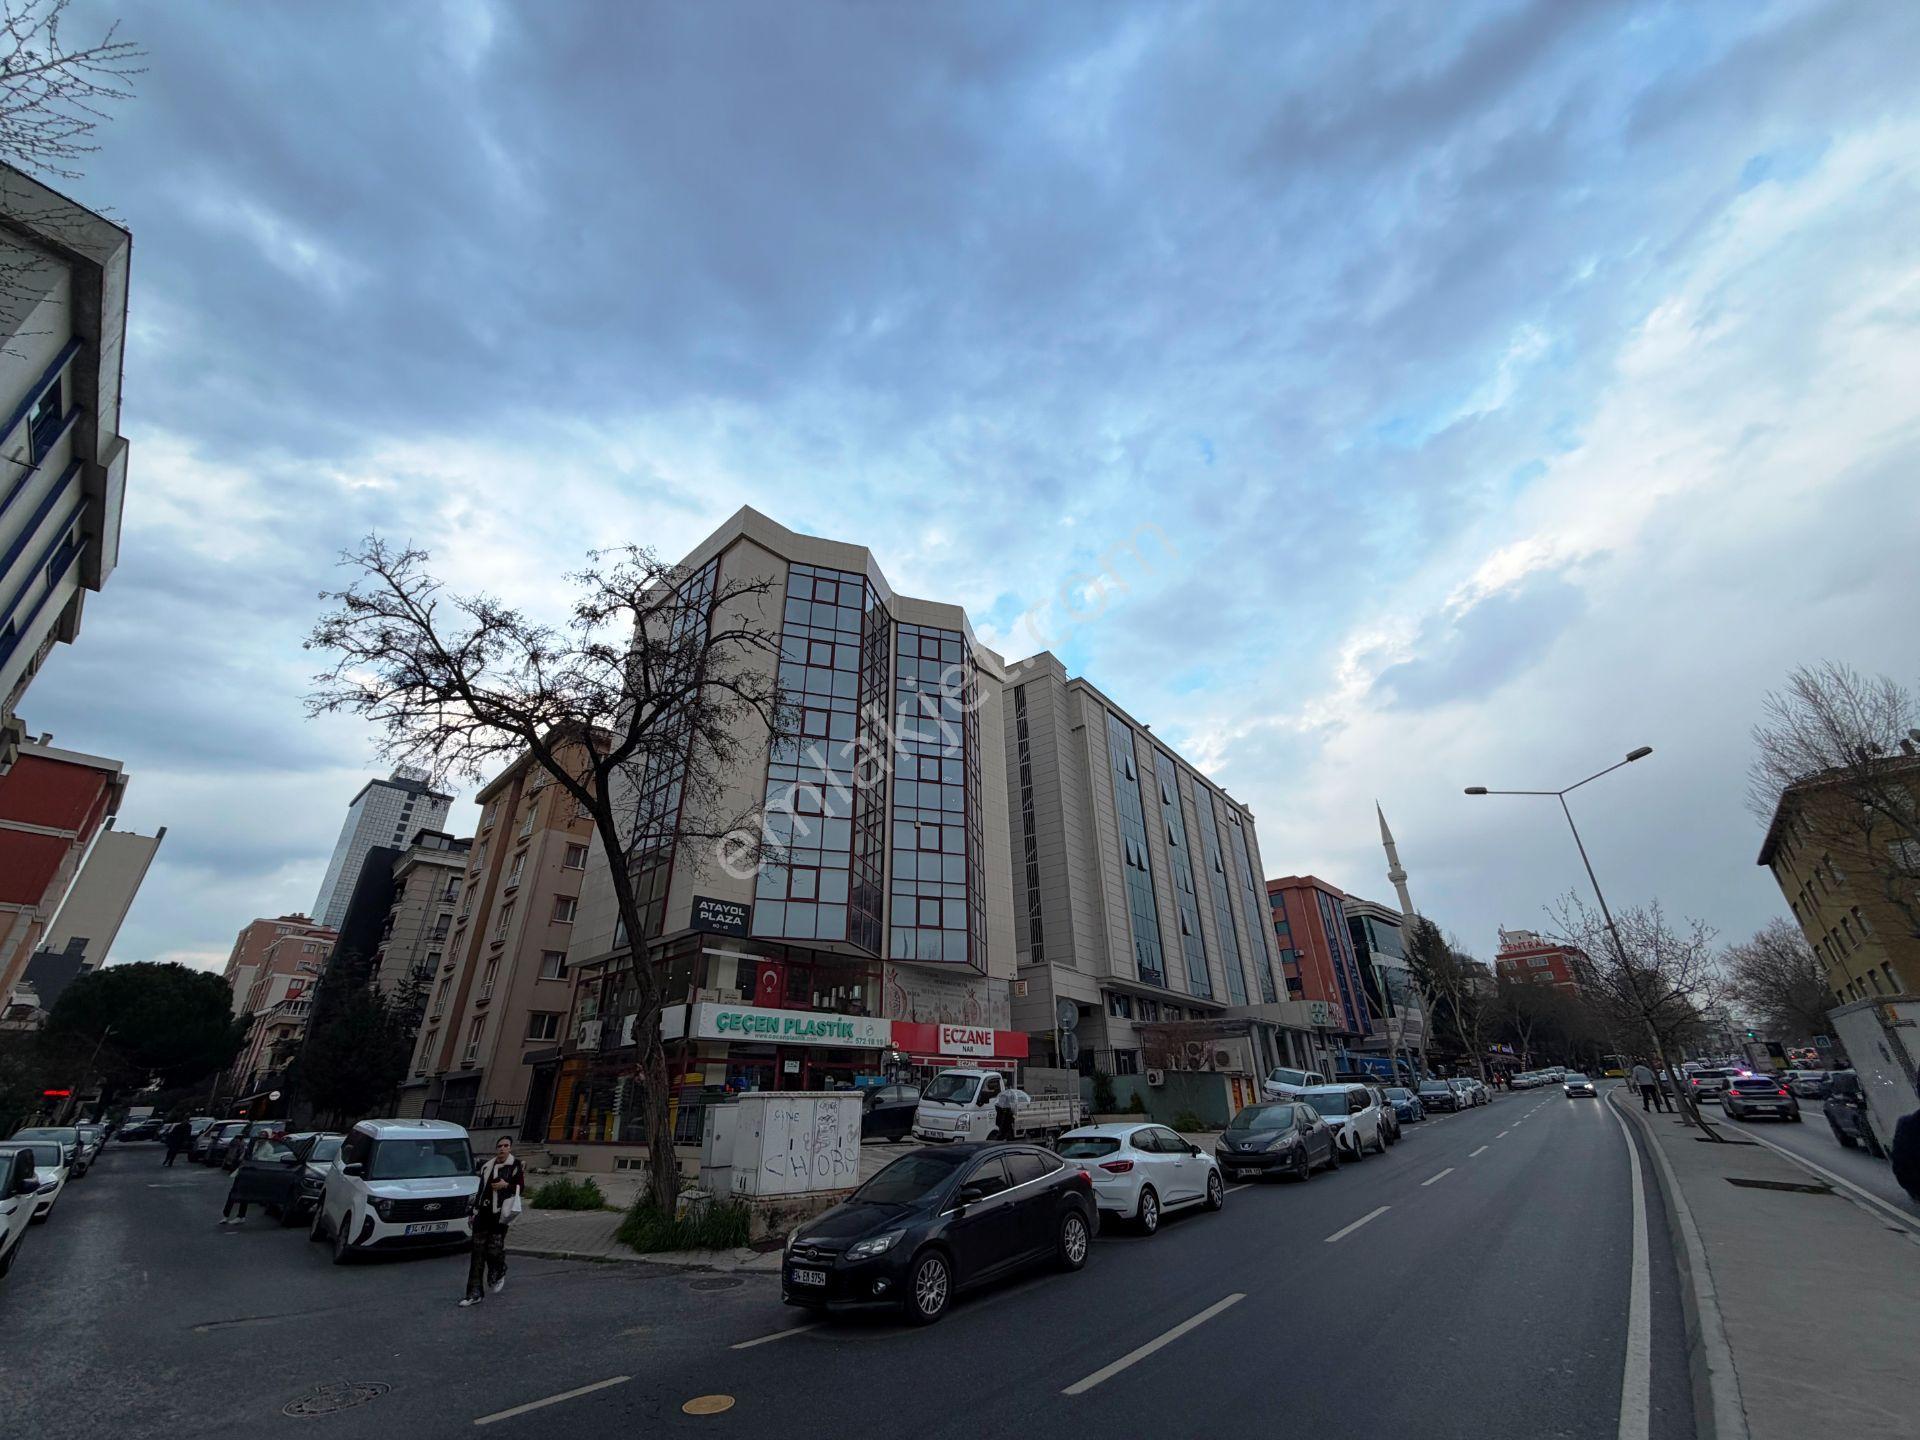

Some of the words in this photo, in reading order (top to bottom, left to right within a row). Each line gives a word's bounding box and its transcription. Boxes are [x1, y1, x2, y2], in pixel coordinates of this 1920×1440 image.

[698, 901, 745, 916] ATAYOL
[700, 911, 742, 926] PLAZA
[1500, 938, 1549, 952] CENTRAL
[715, 1012, 780, 1033] ÇEÇEN
[784, 1017, 854, 1038] PLASTİK
[943, 1028, 992, 1046] ECZANE
